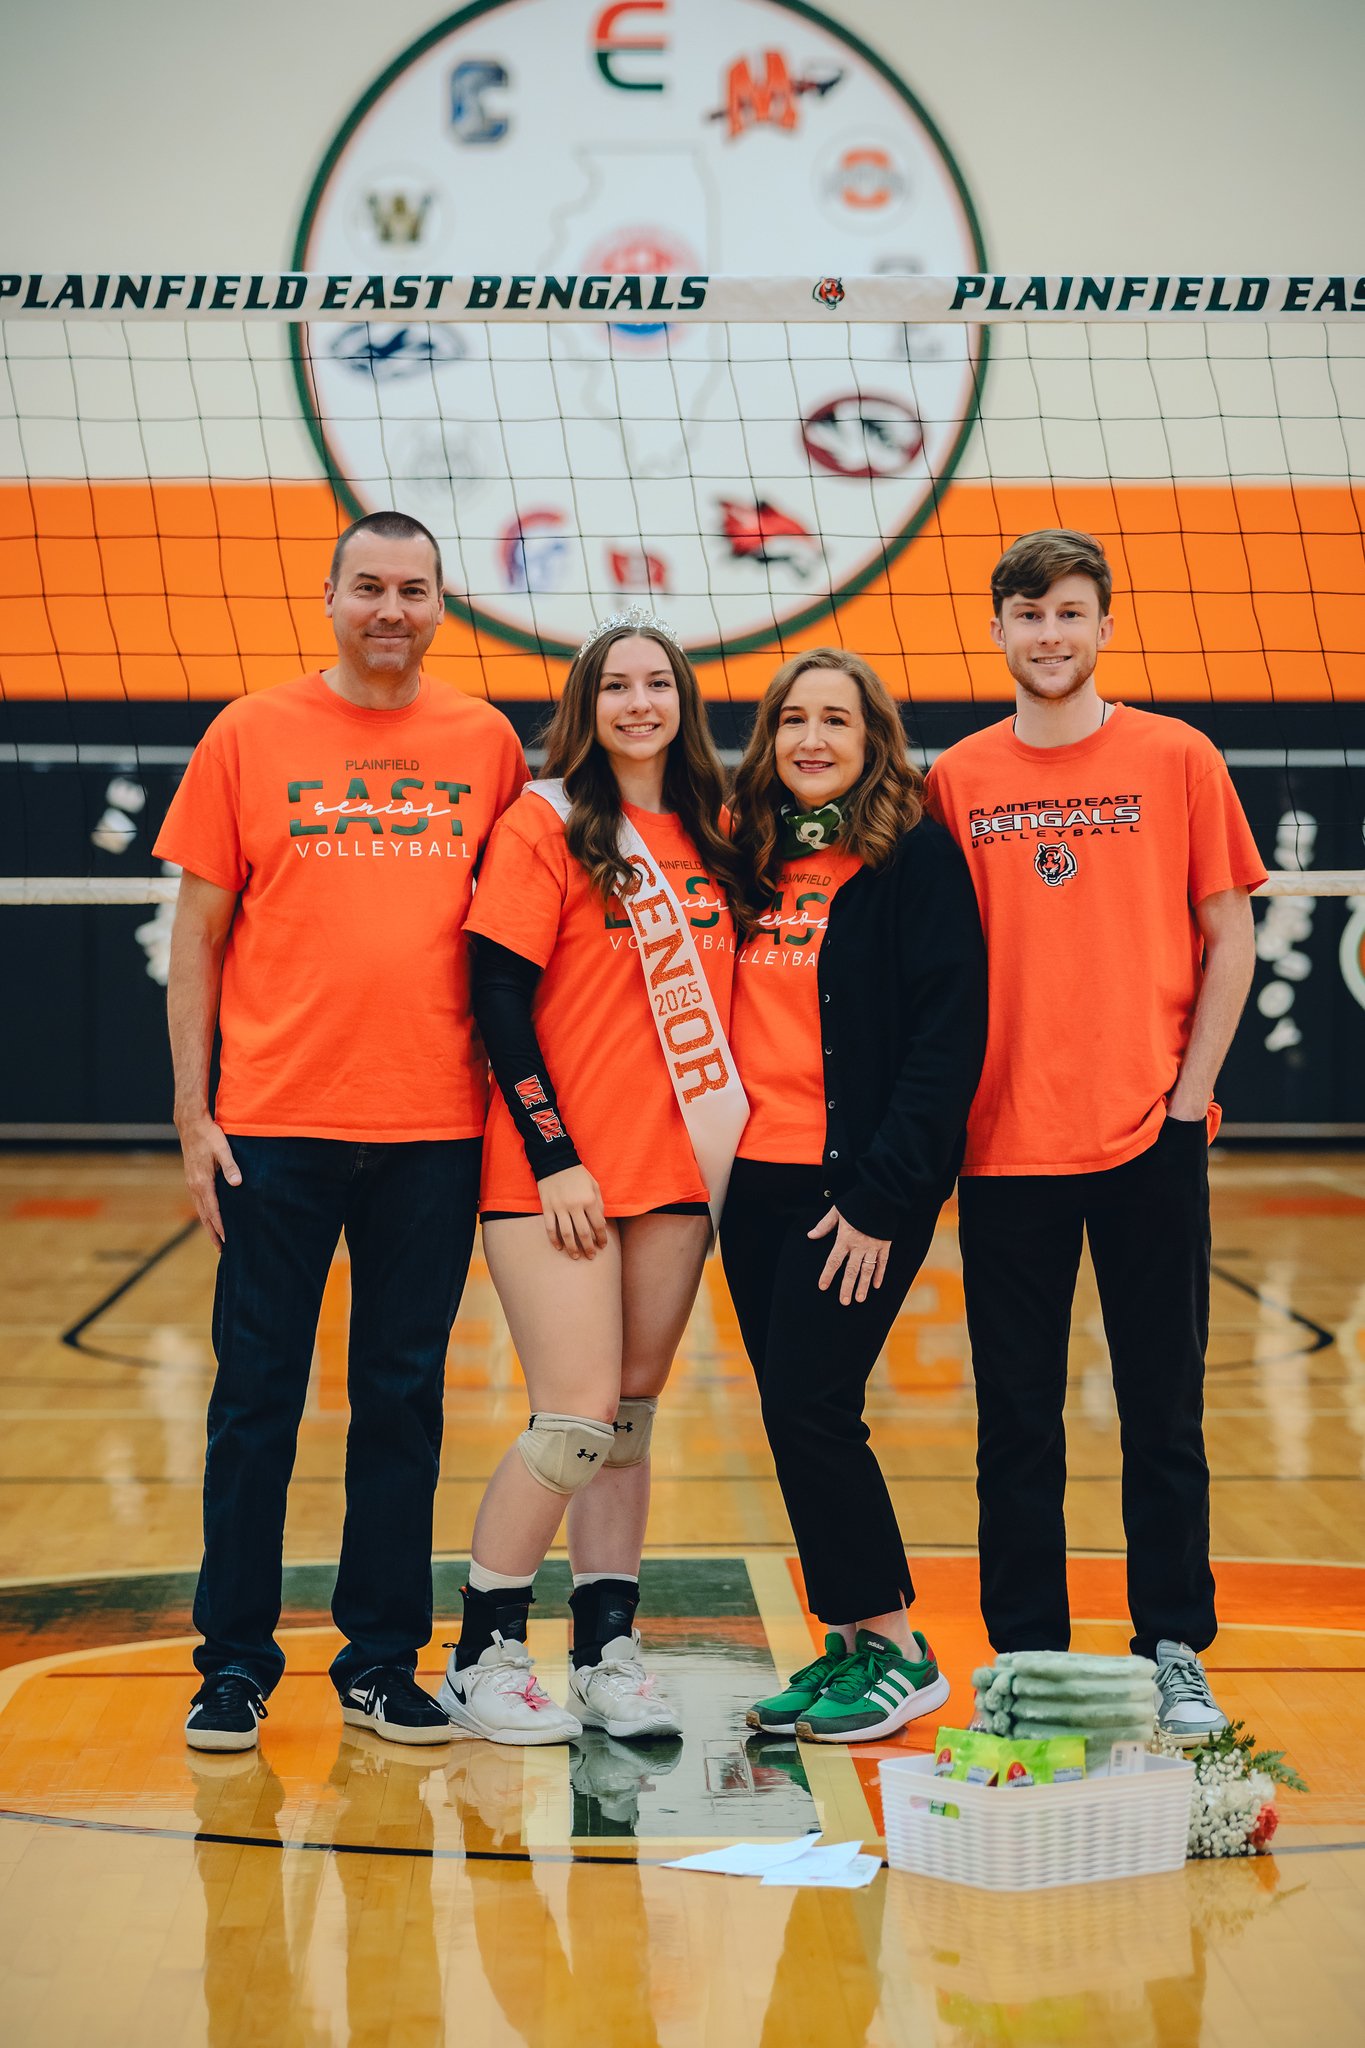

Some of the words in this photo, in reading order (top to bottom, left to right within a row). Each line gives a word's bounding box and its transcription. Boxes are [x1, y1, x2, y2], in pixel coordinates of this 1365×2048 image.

[0, 274, 308, 310] PLAINFIELD
[319, 275, 454, 310] EAST
[464, 275, 710, 310] BENGALS
[949, 276, 1270, 312] PLAINFIELD
[345, 759, 420, 771] PLAINFIELD
[287, 777, 472, 838] EAST
[313, 799, 452, 817] senior
[969, 798, 1082, 820] PLAINFIELD
[1084, 794, 1143, 807] EAST
[969, 805, 1141, 839] BENGALS
[295, 840, 471, 859] VOLLEYBALL
[971, 825, 1140, 849] VOLLEYBALL
[659, 860, 704, 871] AINFIELD
[736, 949, 816, 967] LLEYBA
[654, 980, 703, 1017] 2025
